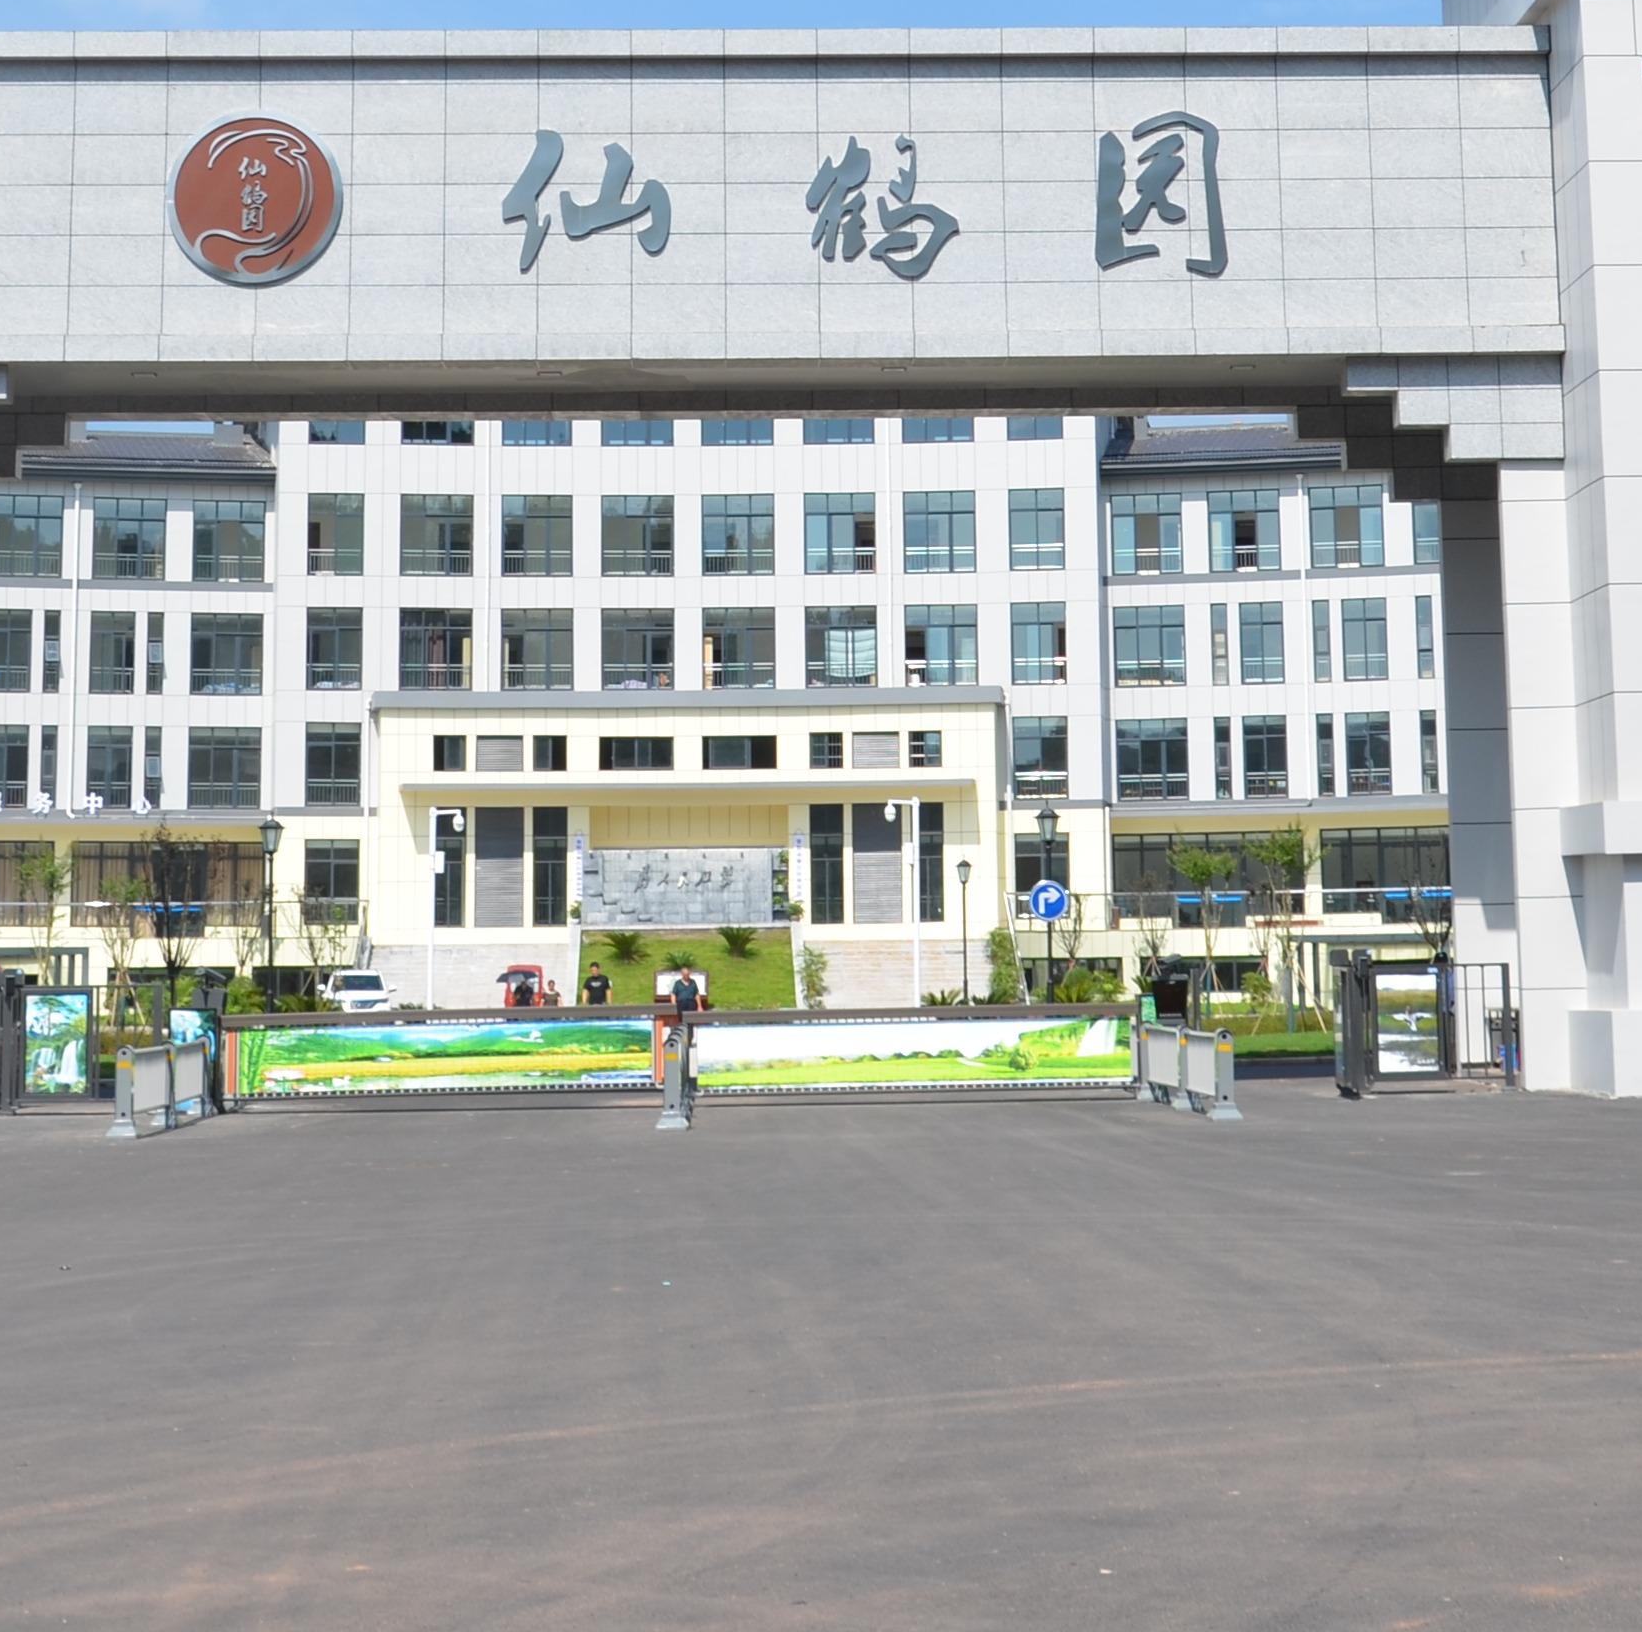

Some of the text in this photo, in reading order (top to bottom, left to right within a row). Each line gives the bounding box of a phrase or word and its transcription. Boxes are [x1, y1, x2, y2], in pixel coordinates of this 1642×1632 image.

[238, 156, 268, 233] 仙鹤园
[503, 110, 1229, 280] 仙鹤园
